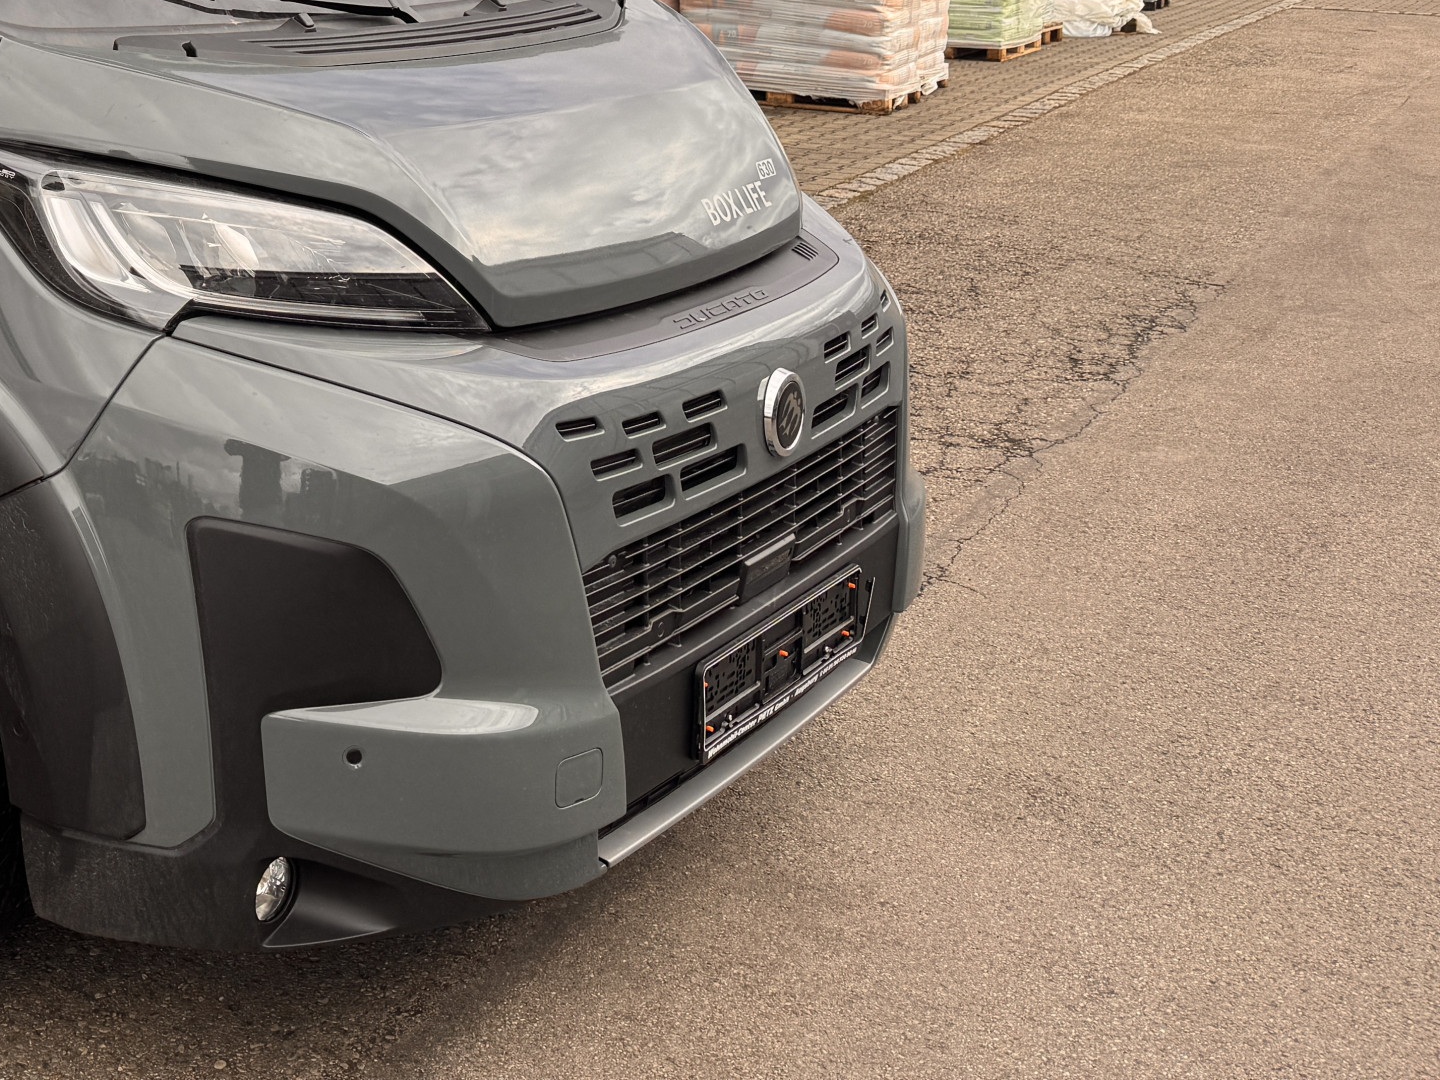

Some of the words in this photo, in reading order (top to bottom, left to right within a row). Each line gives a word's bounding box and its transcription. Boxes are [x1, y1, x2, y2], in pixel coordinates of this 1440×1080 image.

[757, 160, 776, 178] 630
[701, 190, 744, 226] BOX
[734, 180, 773, 214] LIFE
[673, 290, 769, 329] DUCATO
